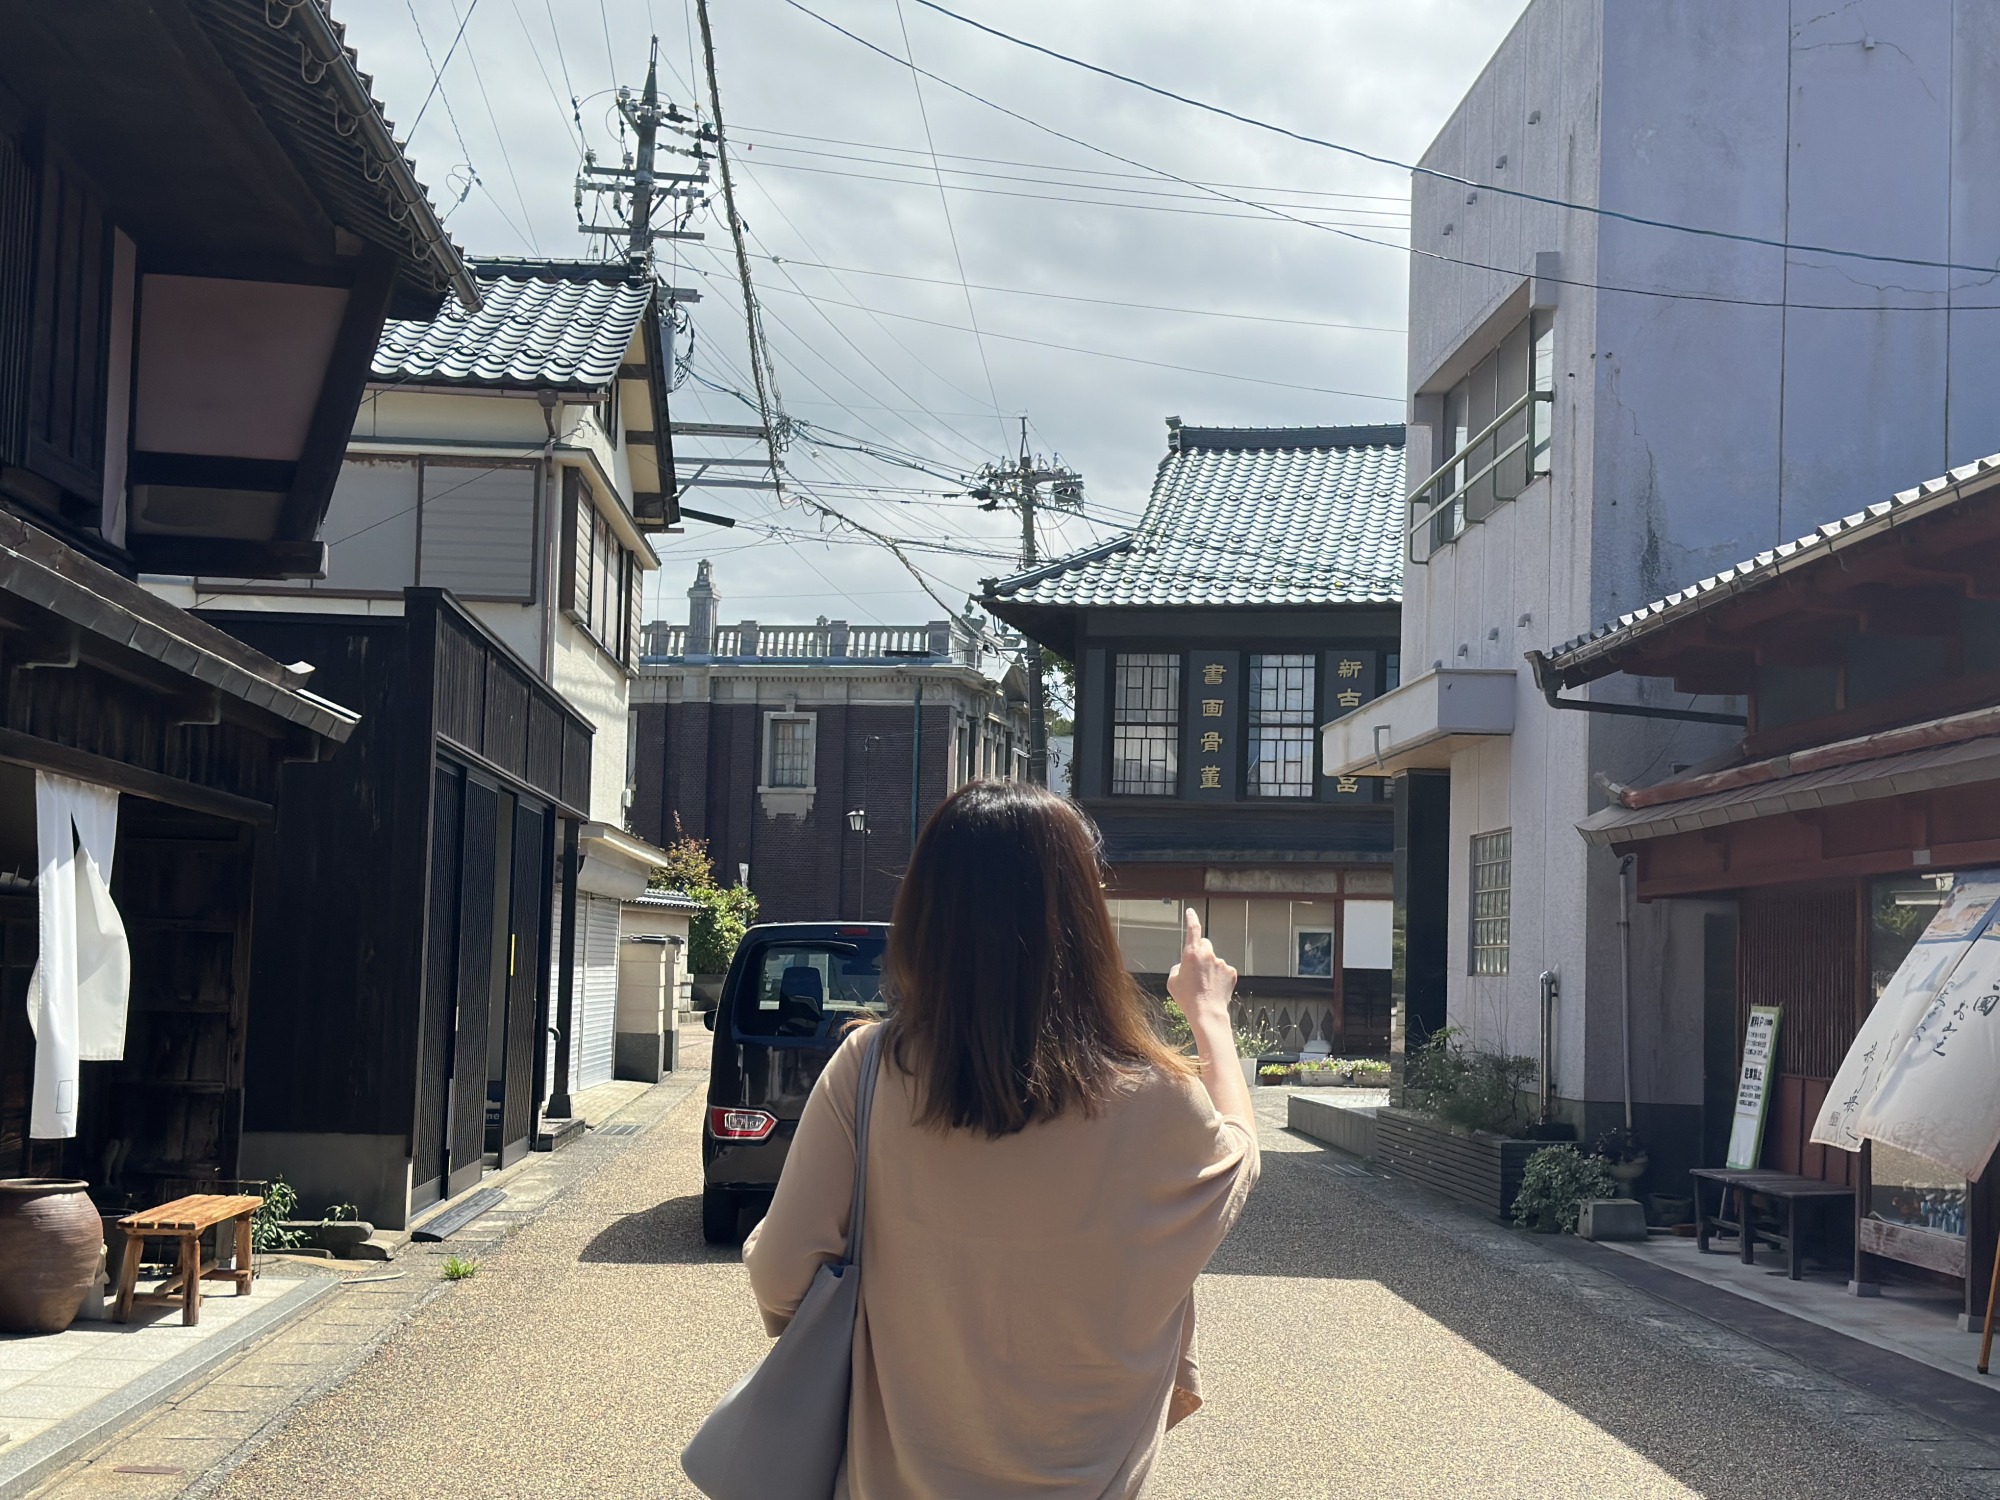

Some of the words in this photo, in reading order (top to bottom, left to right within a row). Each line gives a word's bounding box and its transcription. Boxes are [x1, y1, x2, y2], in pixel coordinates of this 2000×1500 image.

[1200, 663, 1227, 789] 書画骨董
[1336, 658, 1363, 793] 新古品
